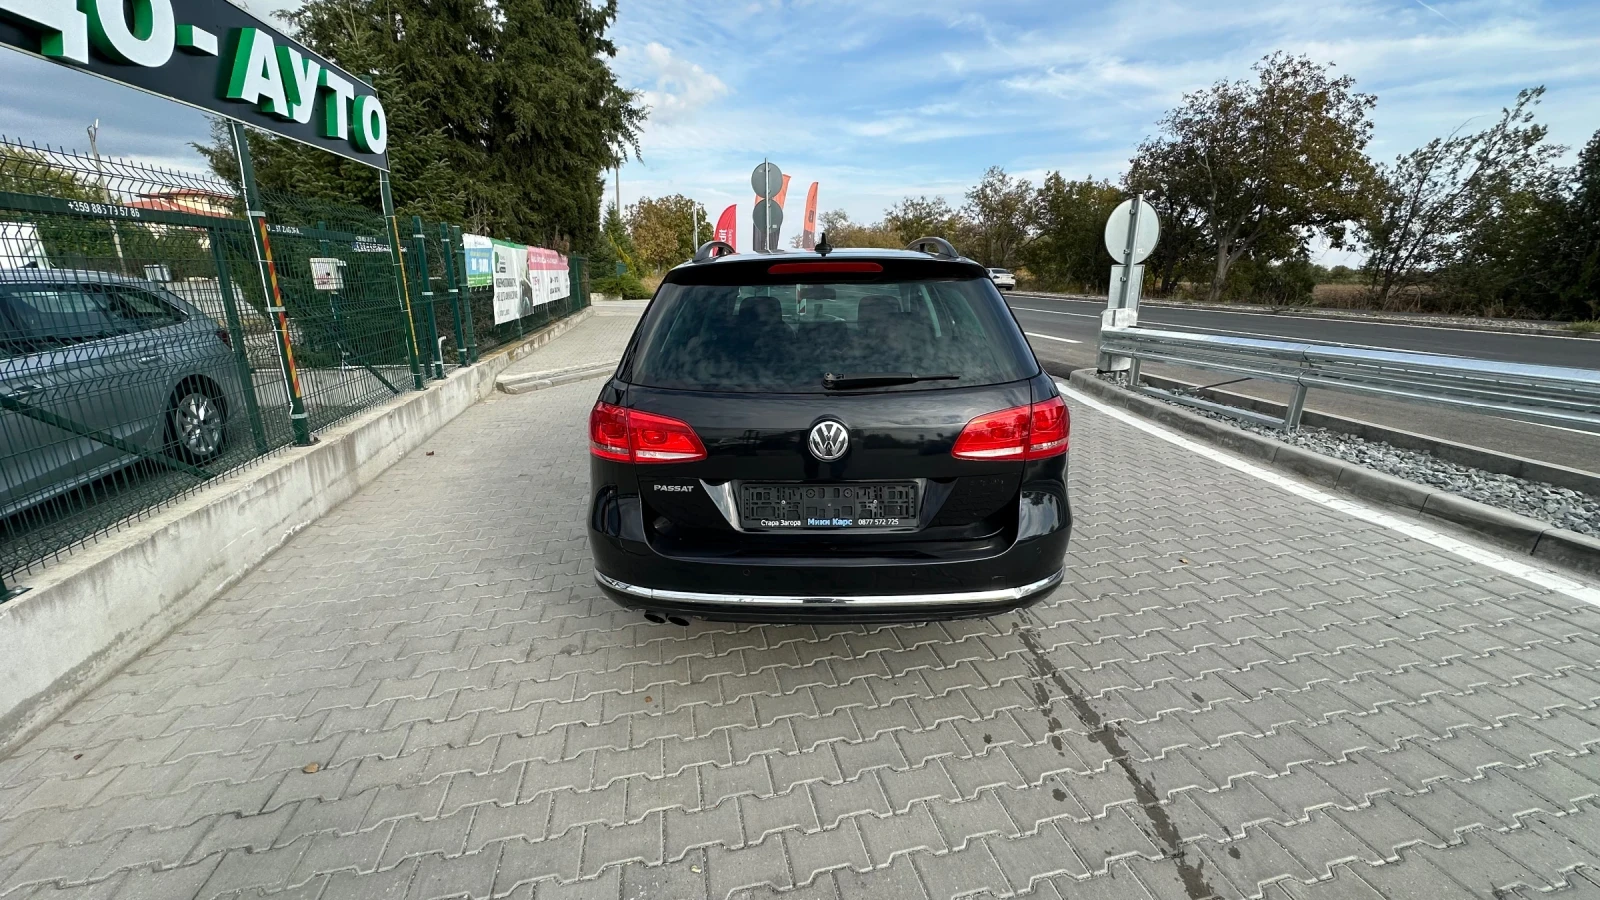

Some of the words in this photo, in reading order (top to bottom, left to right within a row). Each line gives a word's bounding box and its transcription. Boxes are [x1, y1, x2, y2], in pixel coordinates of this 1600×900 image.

[119, 207, 129, 217] 57
[653, 484, 694, 493] PASSAT
[760, 518, 779, 528] Стара
[780, 518, 802, 528] Загора
[807, 517, 831, 526] Мики
[832, 517, 853, 527] Карс
[858, 518, 873, 526] 0877
[874, 518, 886, 526] 572
